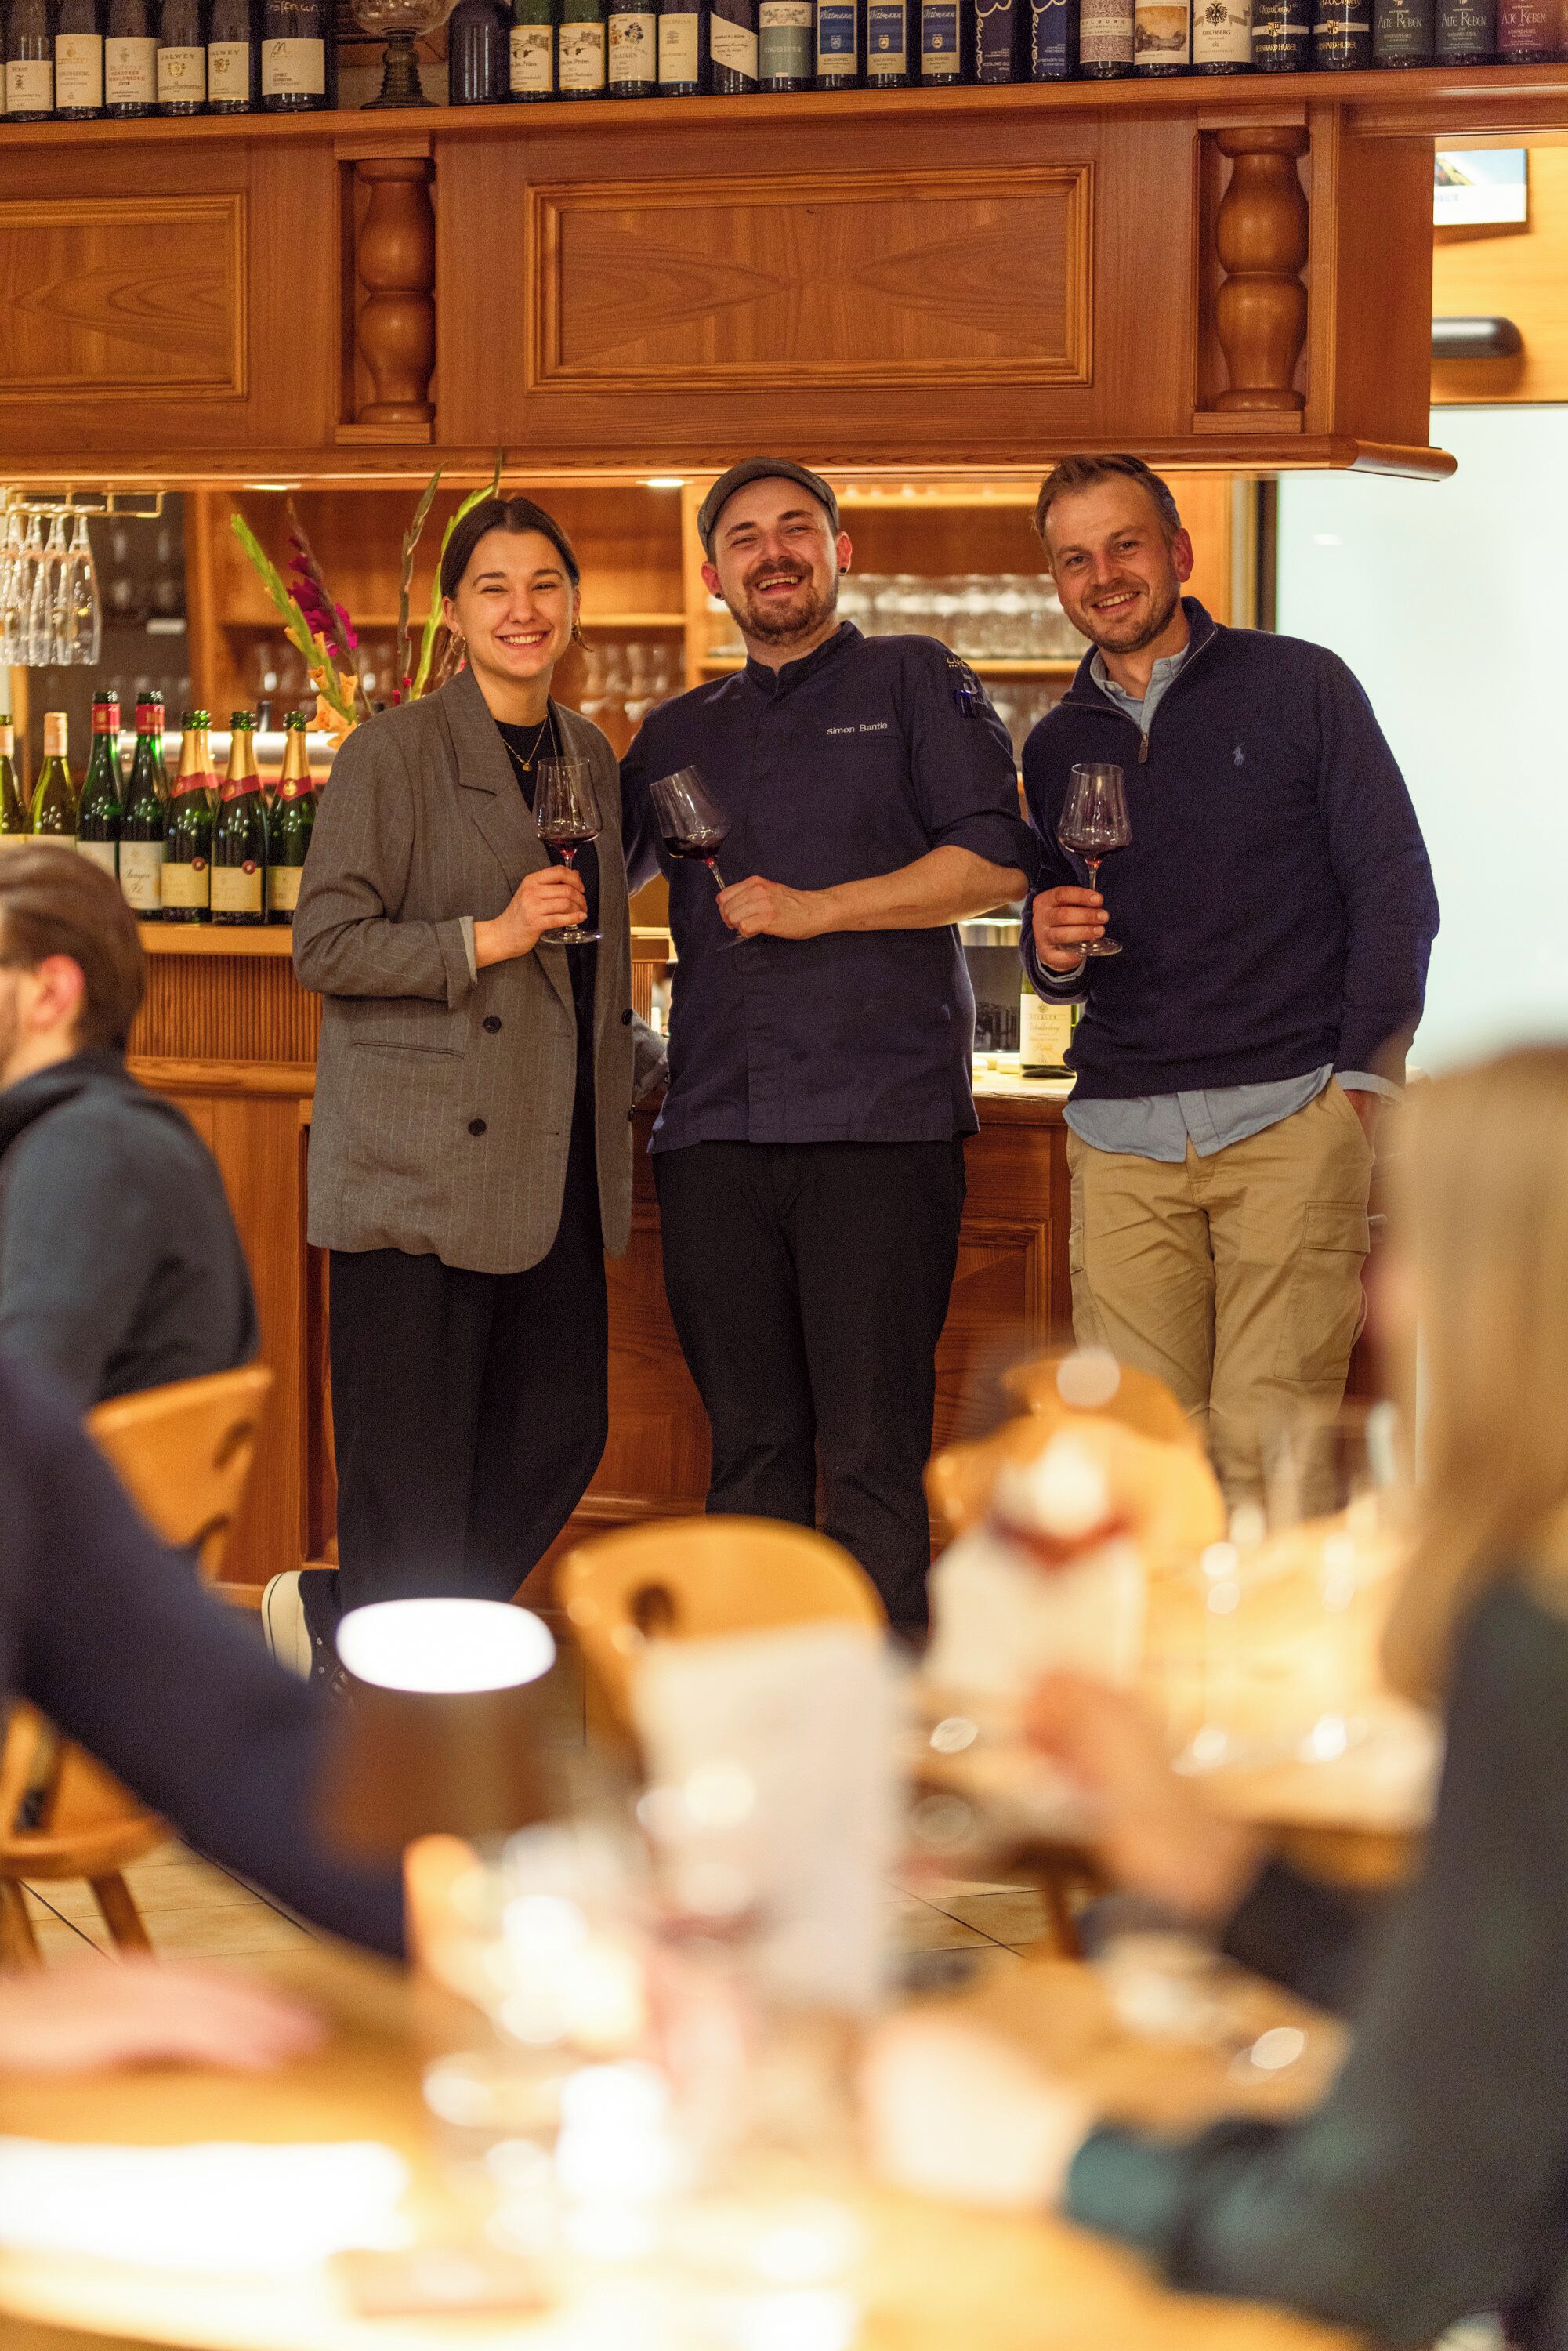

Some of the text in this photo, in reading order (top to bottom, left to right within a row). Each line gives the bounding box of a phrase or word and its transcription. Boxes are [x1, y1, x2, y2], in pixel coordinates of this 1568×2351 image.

[820, 9, 853, 20] Wittmann
[869, 8, 903, 20] Wittmann
[923, 7, 955, 19] Wittmann
[859, 721, 888, 732] Bantle
